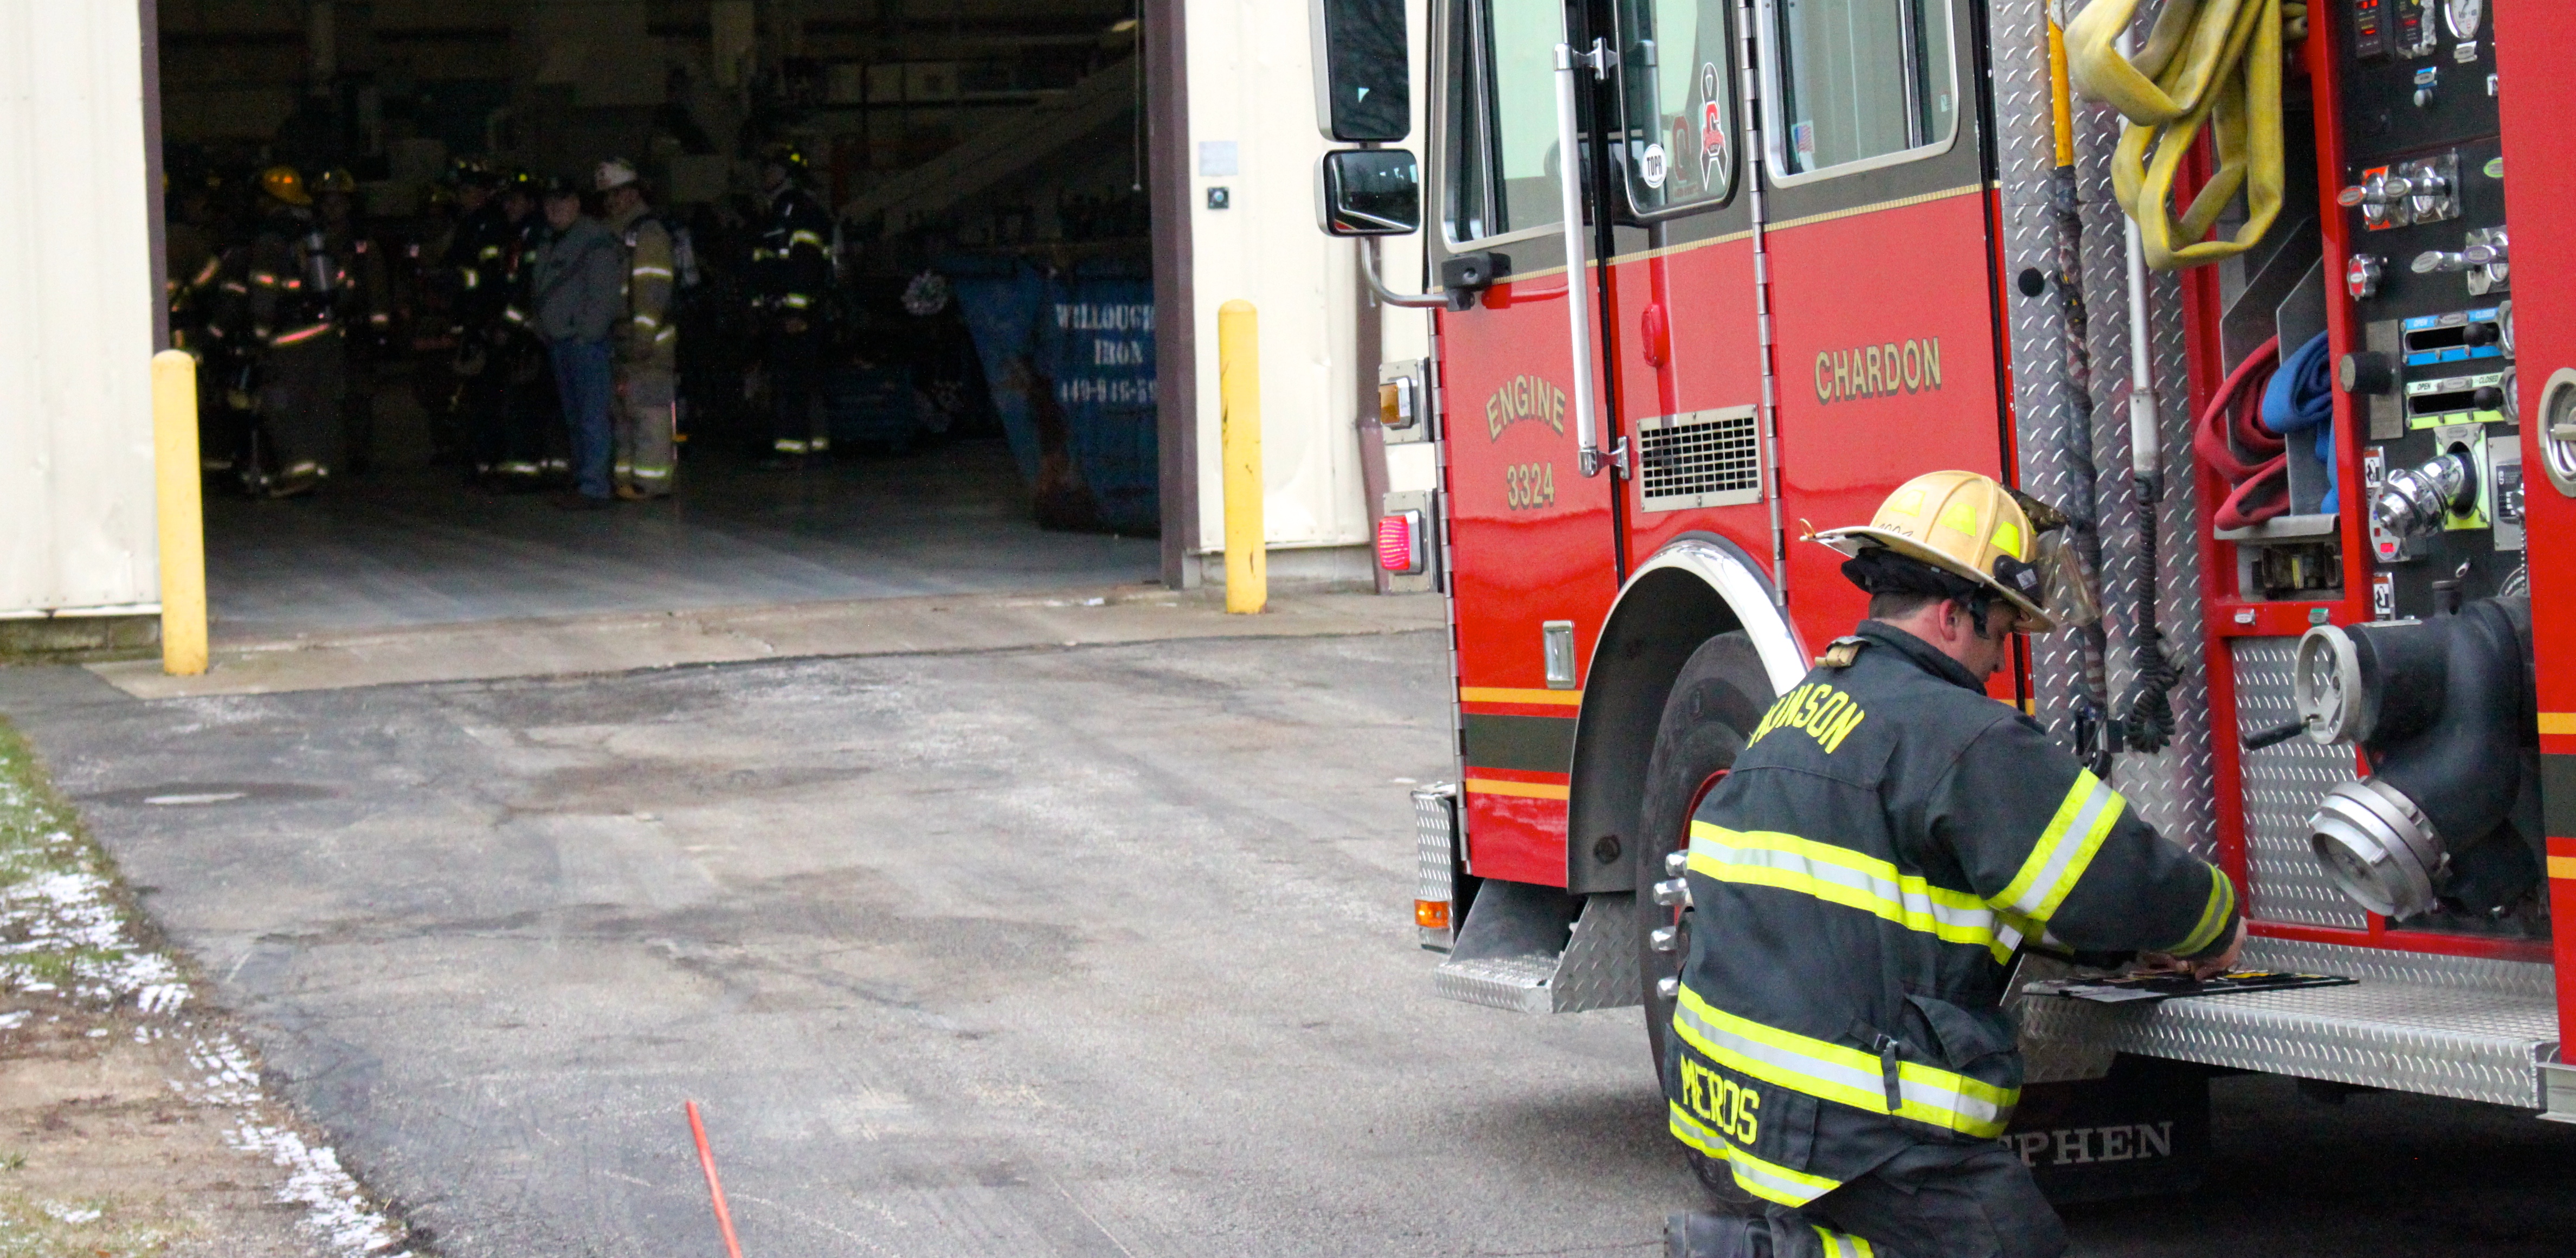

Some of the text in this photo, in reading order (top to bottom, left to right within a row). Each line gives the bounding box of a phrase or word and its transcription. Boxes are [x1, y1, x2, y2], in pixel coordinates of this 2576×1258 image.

[1647, 155, 1663, 177] TOPR
[2413, 309, 2495, 327] OPEN CLOSED
[1094, 338, 1144, 365] IRON
[1815, 336, 1941, 406] CHARDON
[2417, 375, 2499, 390] OPEN CLOSED
[1486, 374, 1566, 444] ENGINE
[1507, 462, 1555, 510] 3324
[1746, 683, 1865, 754] MUNSON
[1680, 1053, 1760, 1145] MEROS
